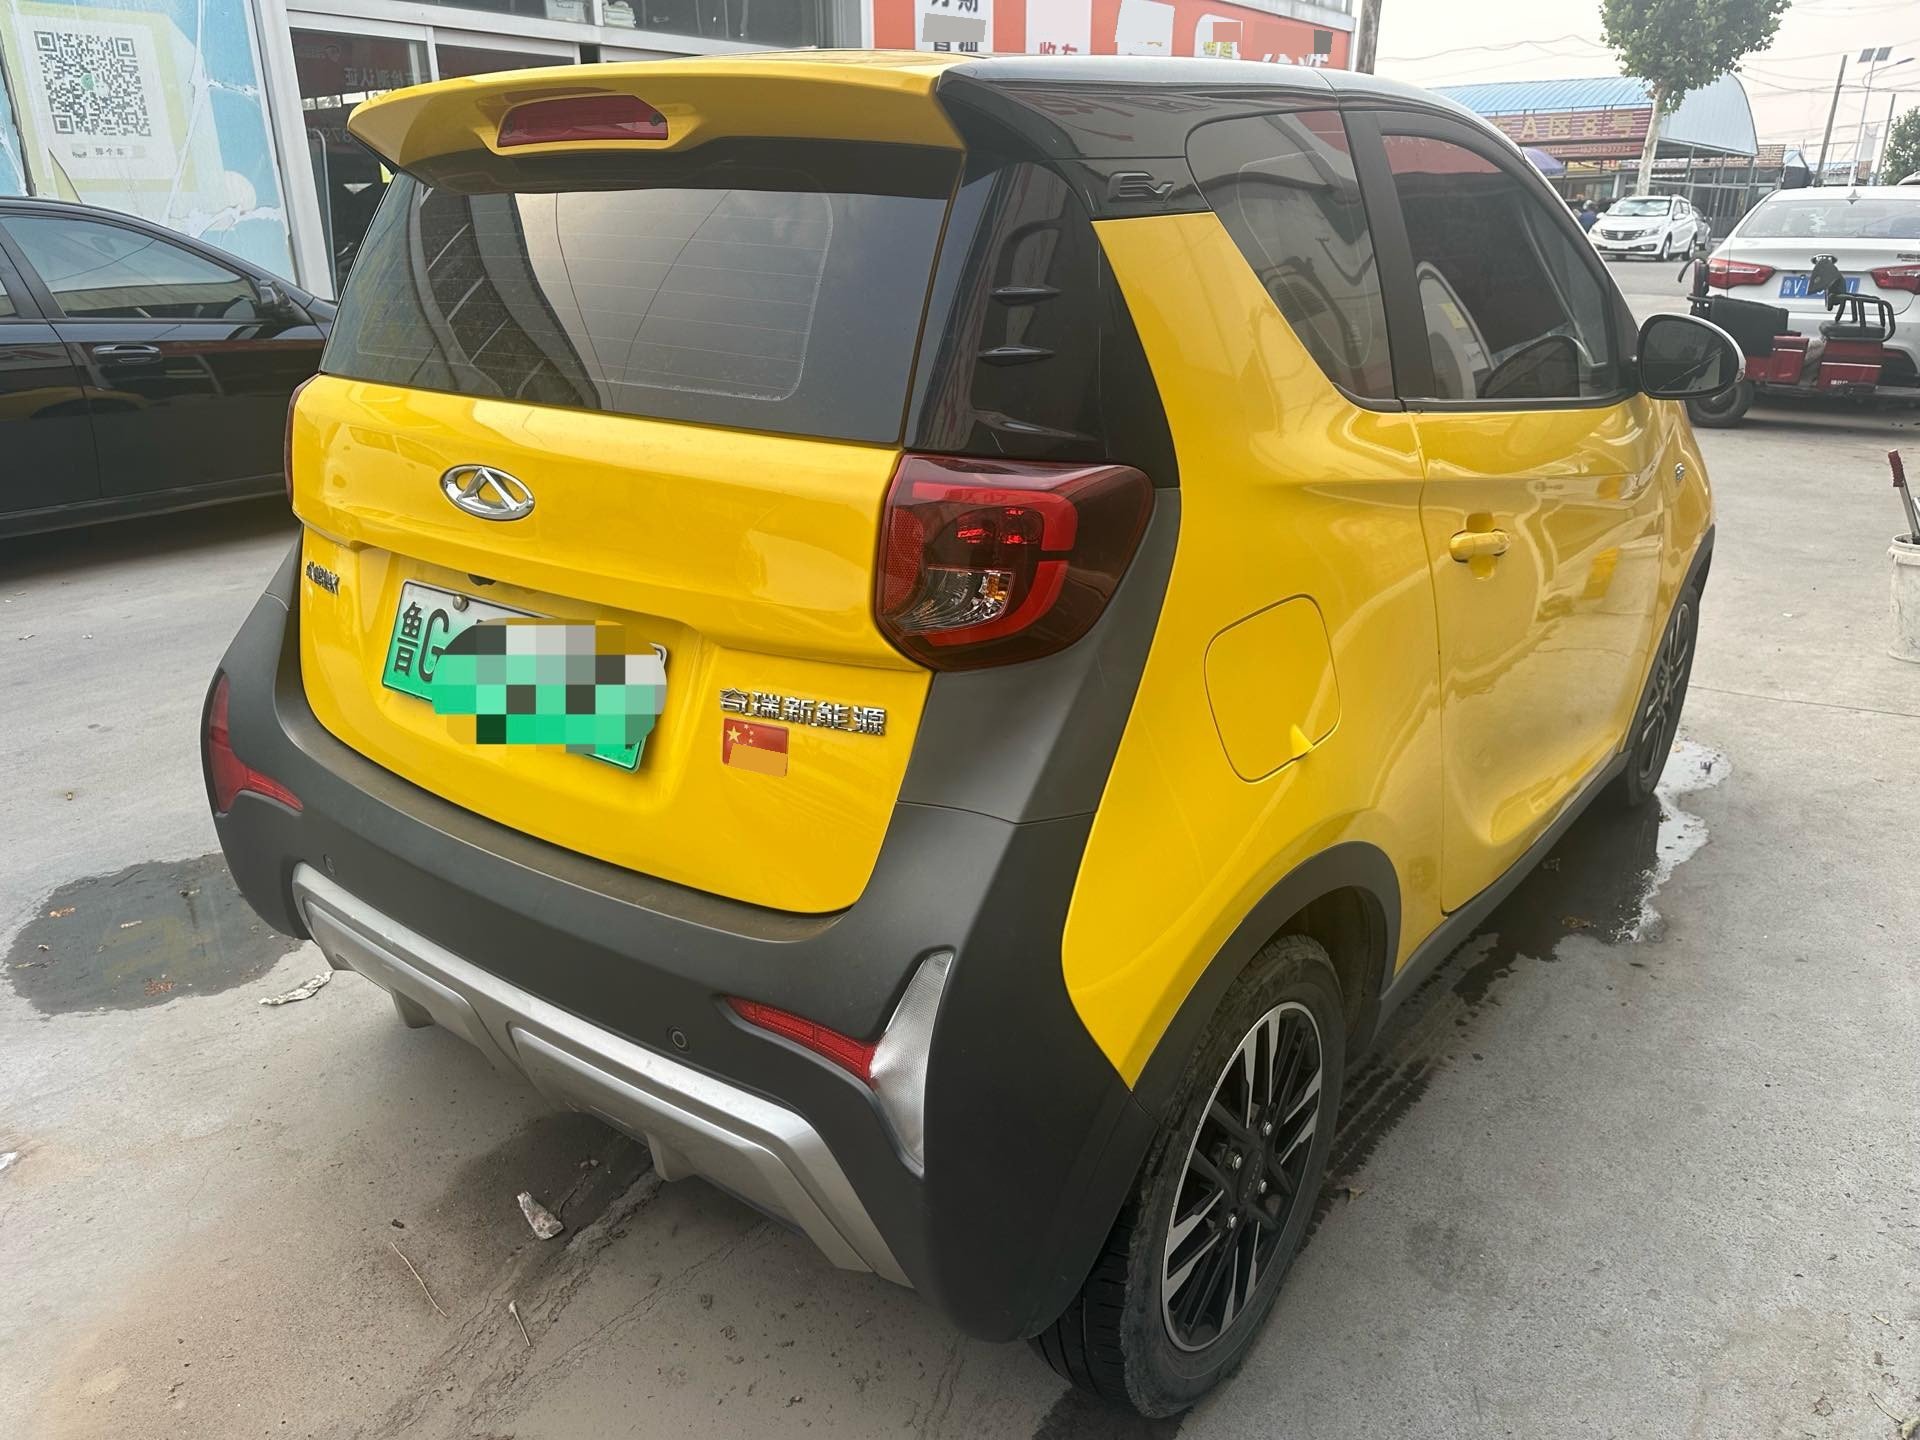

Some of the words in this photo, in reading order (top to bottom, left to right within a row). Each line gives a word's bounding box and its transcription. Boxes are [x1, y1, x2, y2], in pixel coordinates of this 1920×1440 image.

[718, 686, 887, 736] 奇瑞新能源
